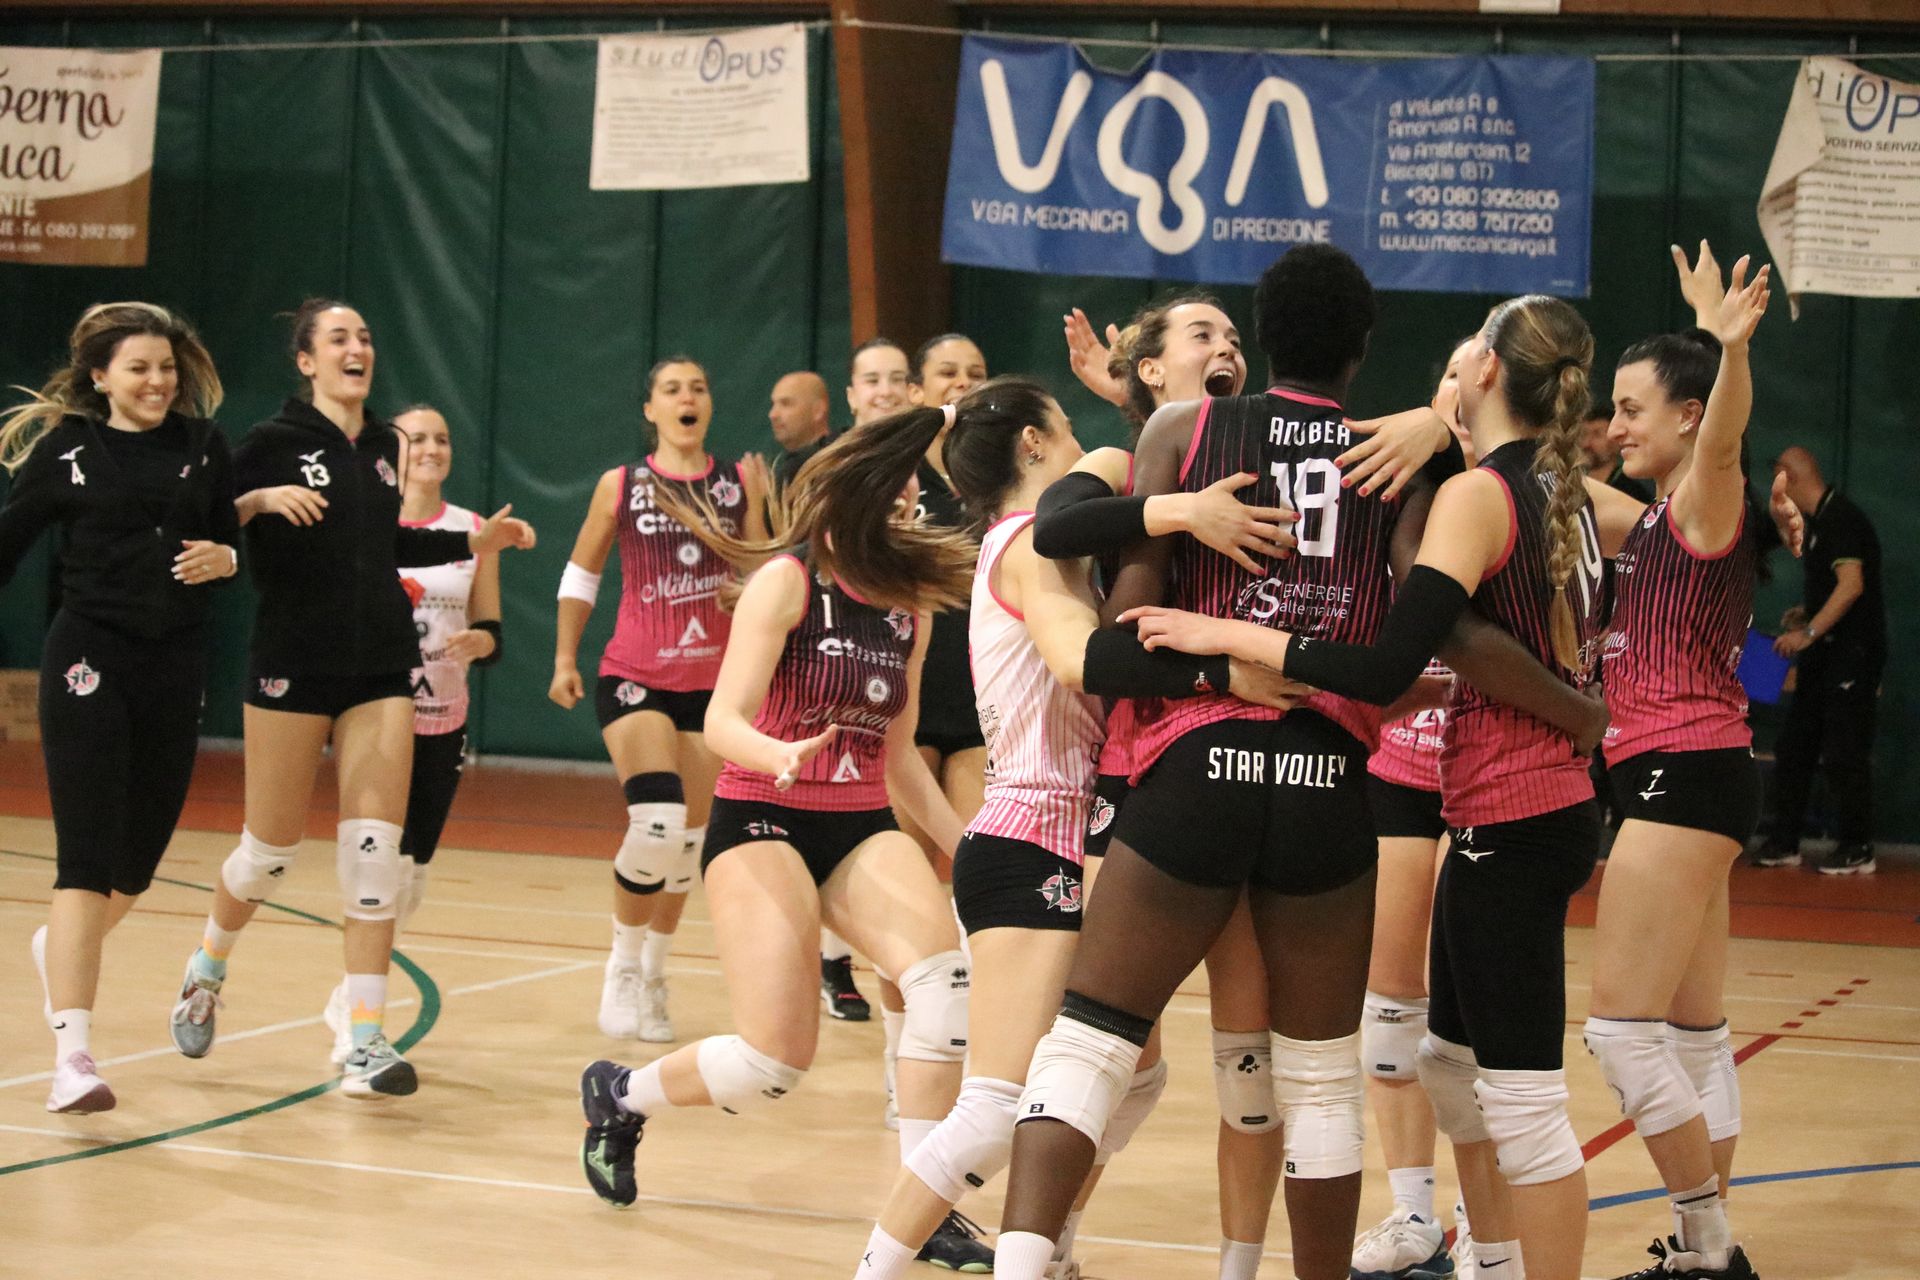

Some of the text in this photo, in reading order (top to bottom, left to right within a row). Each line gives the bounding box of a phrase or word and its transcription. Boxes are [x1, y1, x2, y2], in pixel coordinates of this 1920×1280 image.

[700, 36, 786, 82] OPUS
[1875, 140, 1920, 153] SERVIZ
[1023, 203, 1129, 233] MECCANICA
[1231, 216, 1331, 243] PRECISIONE
[300, 463, 331, 488] 13
[1270, 457, 1341, 557] 18
[1283, 583, 1353, 604] ENERGIE
[1279, 600, 1348, 619] alternative
[1207, 747, 1347, 789] STAR VOLLEY
